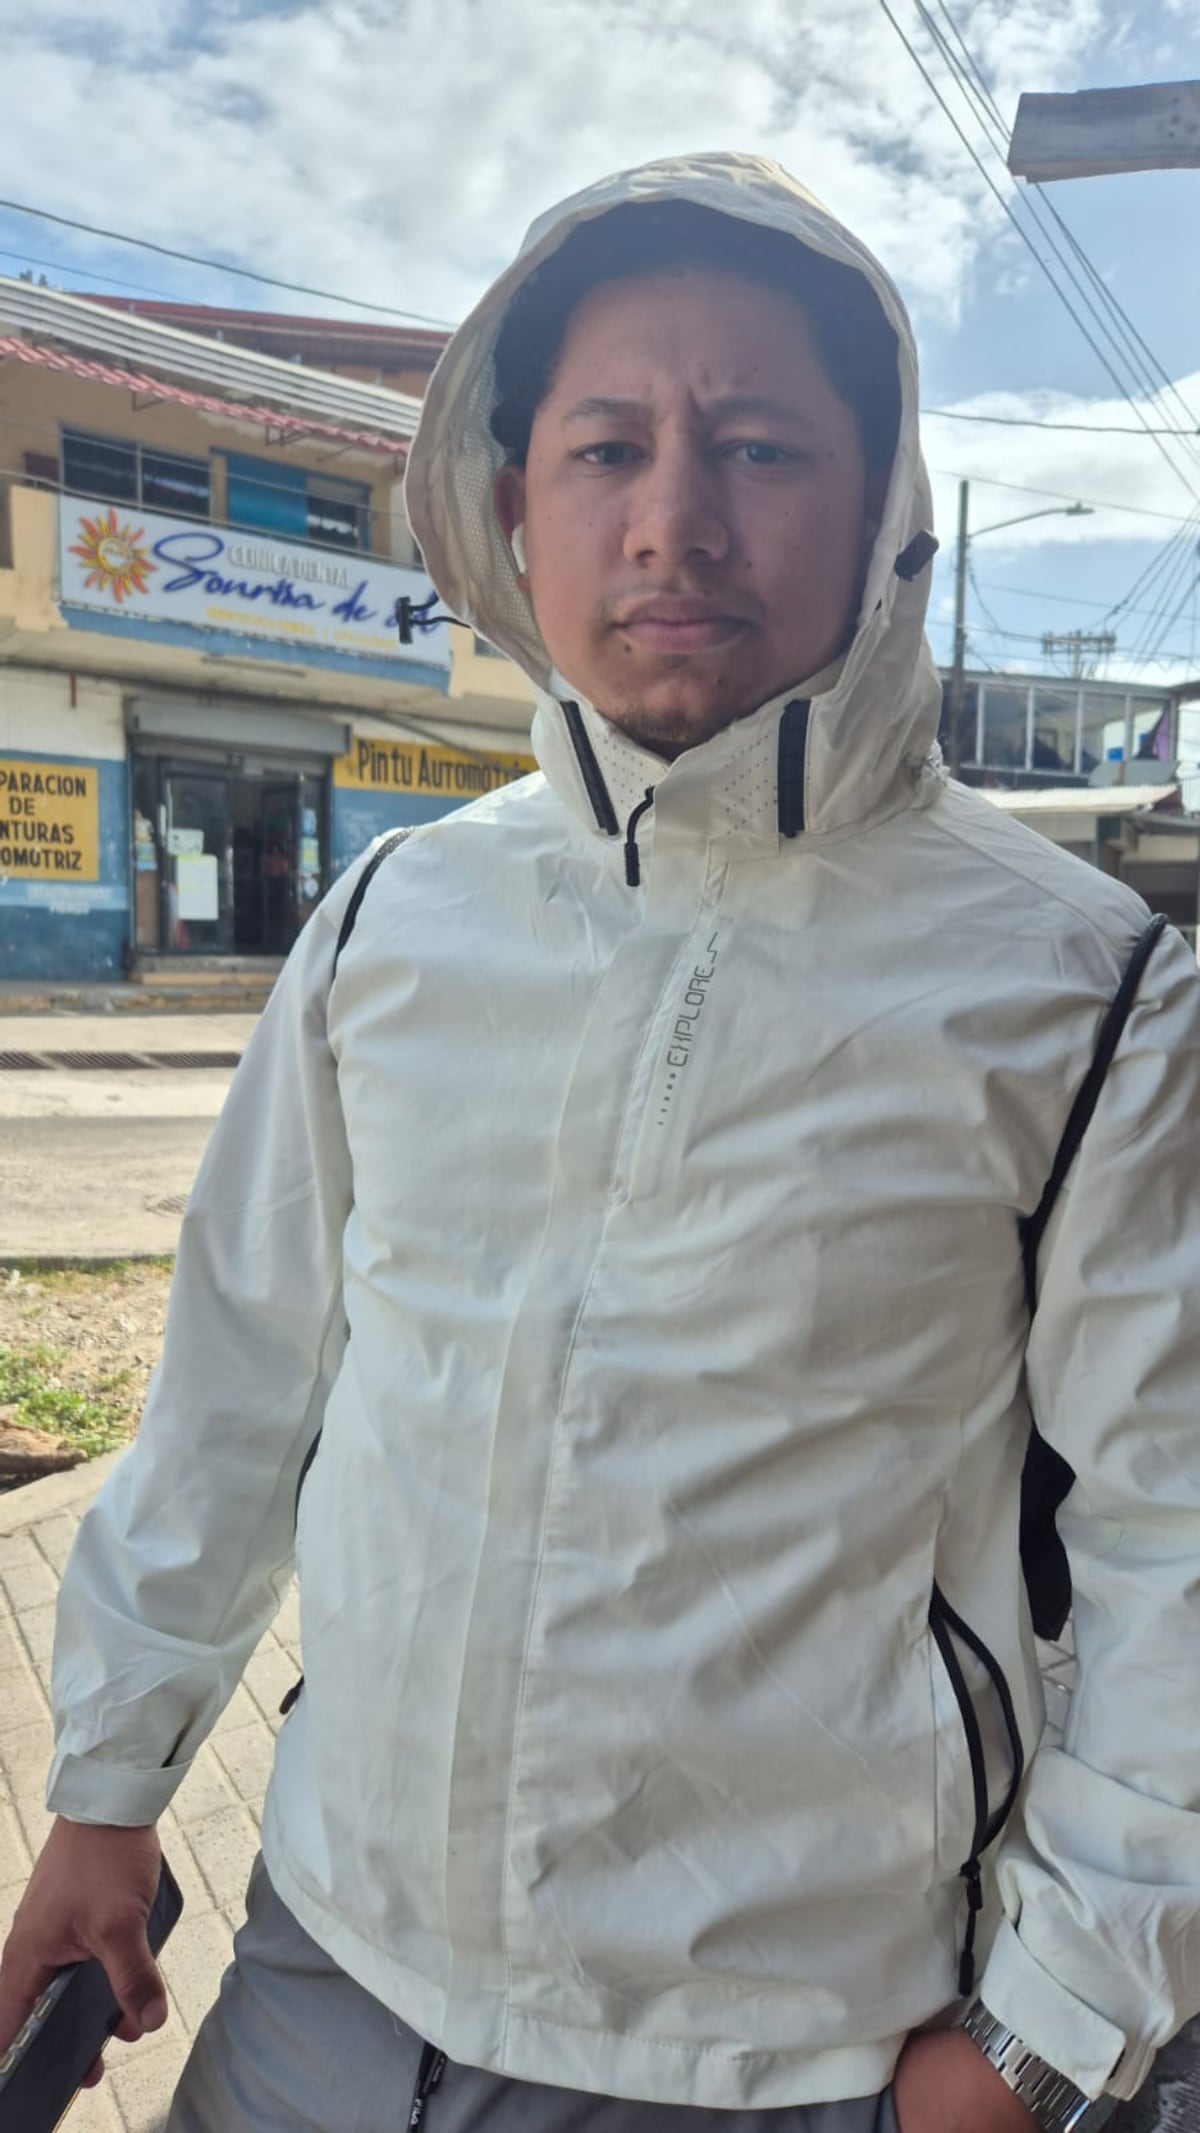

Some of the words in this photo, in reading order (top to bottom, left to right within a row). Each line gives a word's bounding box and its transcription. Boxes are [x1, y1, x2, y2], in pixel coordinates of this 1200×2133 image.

[153, 532, 326, 611] Sonrisa
[331, 579, 379, 623] de
[356, 741, 413, 786] Pintu
[9, 795, 36, 816] DE
[0, 820, 75, 845] NTURAS
[1, 845, 82, 872] OMOTRIZ
